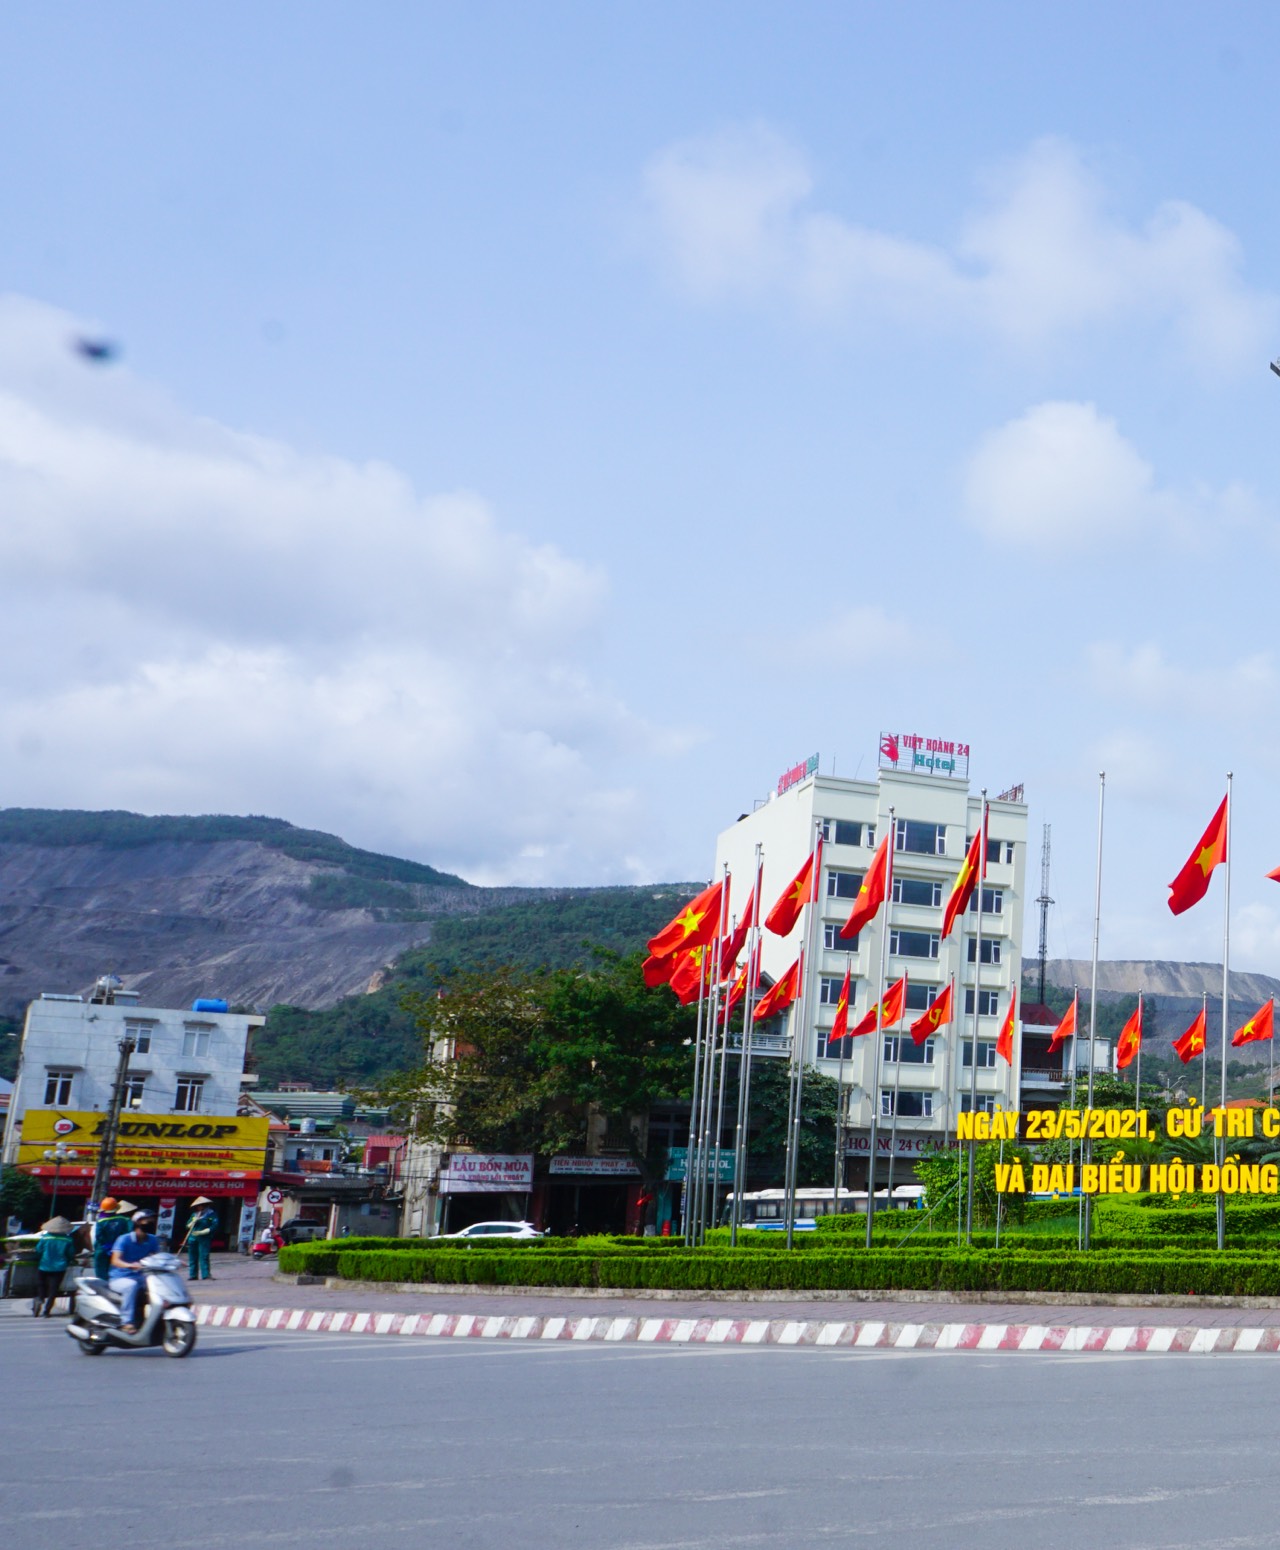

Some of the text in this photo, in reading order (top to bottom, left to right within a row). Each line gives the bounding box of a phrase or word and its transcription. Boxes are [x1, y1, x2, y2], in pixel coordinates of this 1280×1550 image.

[926, 737, 955, 754] HOÀNG
[957, 743, 969, 757] 24
[914, 754, 956, 770] Hotel
[957, 1104, 1020, 1140] NGÀY
[1026, 1109, 1156, 1142] 23/5/2021,
[1166, 1096, 1205, 1138] CỬ
[1211, 1108, 1254, 1138] TRI
[898, 1139, 913, 1152] 24
[503, 1159, 530, 1172] MÙA
[995, 1157, 1026, 1193] VÀ
[1032, 1163, 1075, 1200] ĐẠI
[1082, 1151, 1142, 1194] BIỂU
[1150, 1157, 1195, 1200] HỘI
[1201, 1154, 1279, 1194] ĐỒNG
[138, 1179, 154, 1190] VỤ
